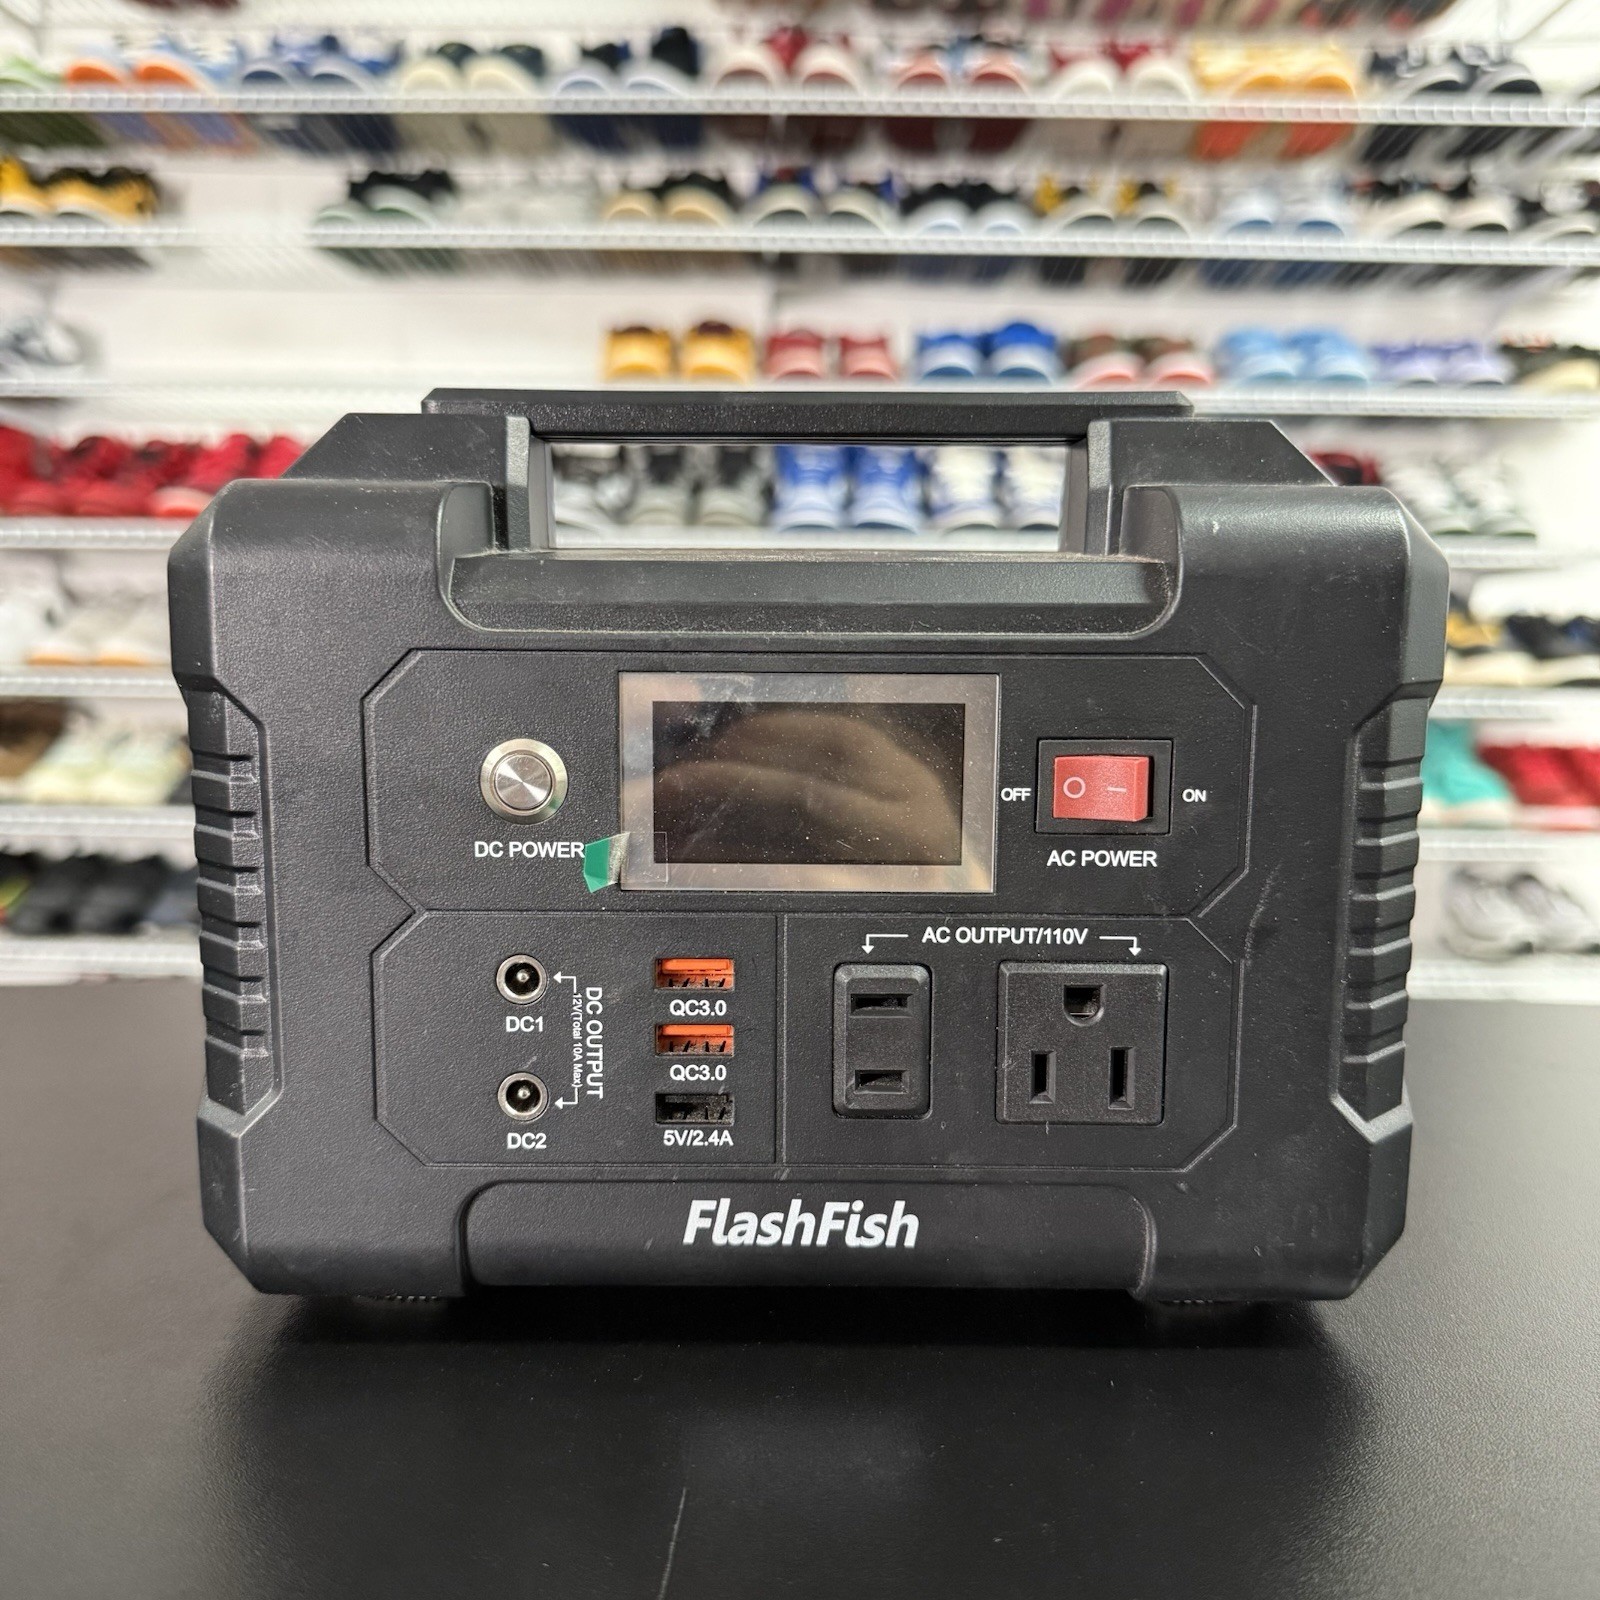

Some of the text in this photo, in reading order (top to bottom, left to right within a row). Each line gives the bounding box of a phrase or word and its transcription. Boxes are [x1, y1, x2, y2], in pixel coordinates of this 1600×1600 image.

[1000, 787, 1032, 802] OFF
[1182, 788, 1207, 803] ON
[474, 840, 585, 859] DC POWER
[1046, 849, 1158, 868] AC POWER
[921, 926, 1089, 945] AC OUTPUT/110V
[669, 998, 728, 1017] QC3.0
[505, 1015, 544, 1033] DC1
[570, 993, 583, 1088] 12V(Total 10A Max)
[585, 986, 604, 1100] DC OUTPUT
[669, 1063, 728, 1082] QC3.0
[506, 1131, 548, 1150] DC2
[663, 1128, 734, 1147] 5V/2.4A
[682, 1197, 920, 1249] FlashFish
